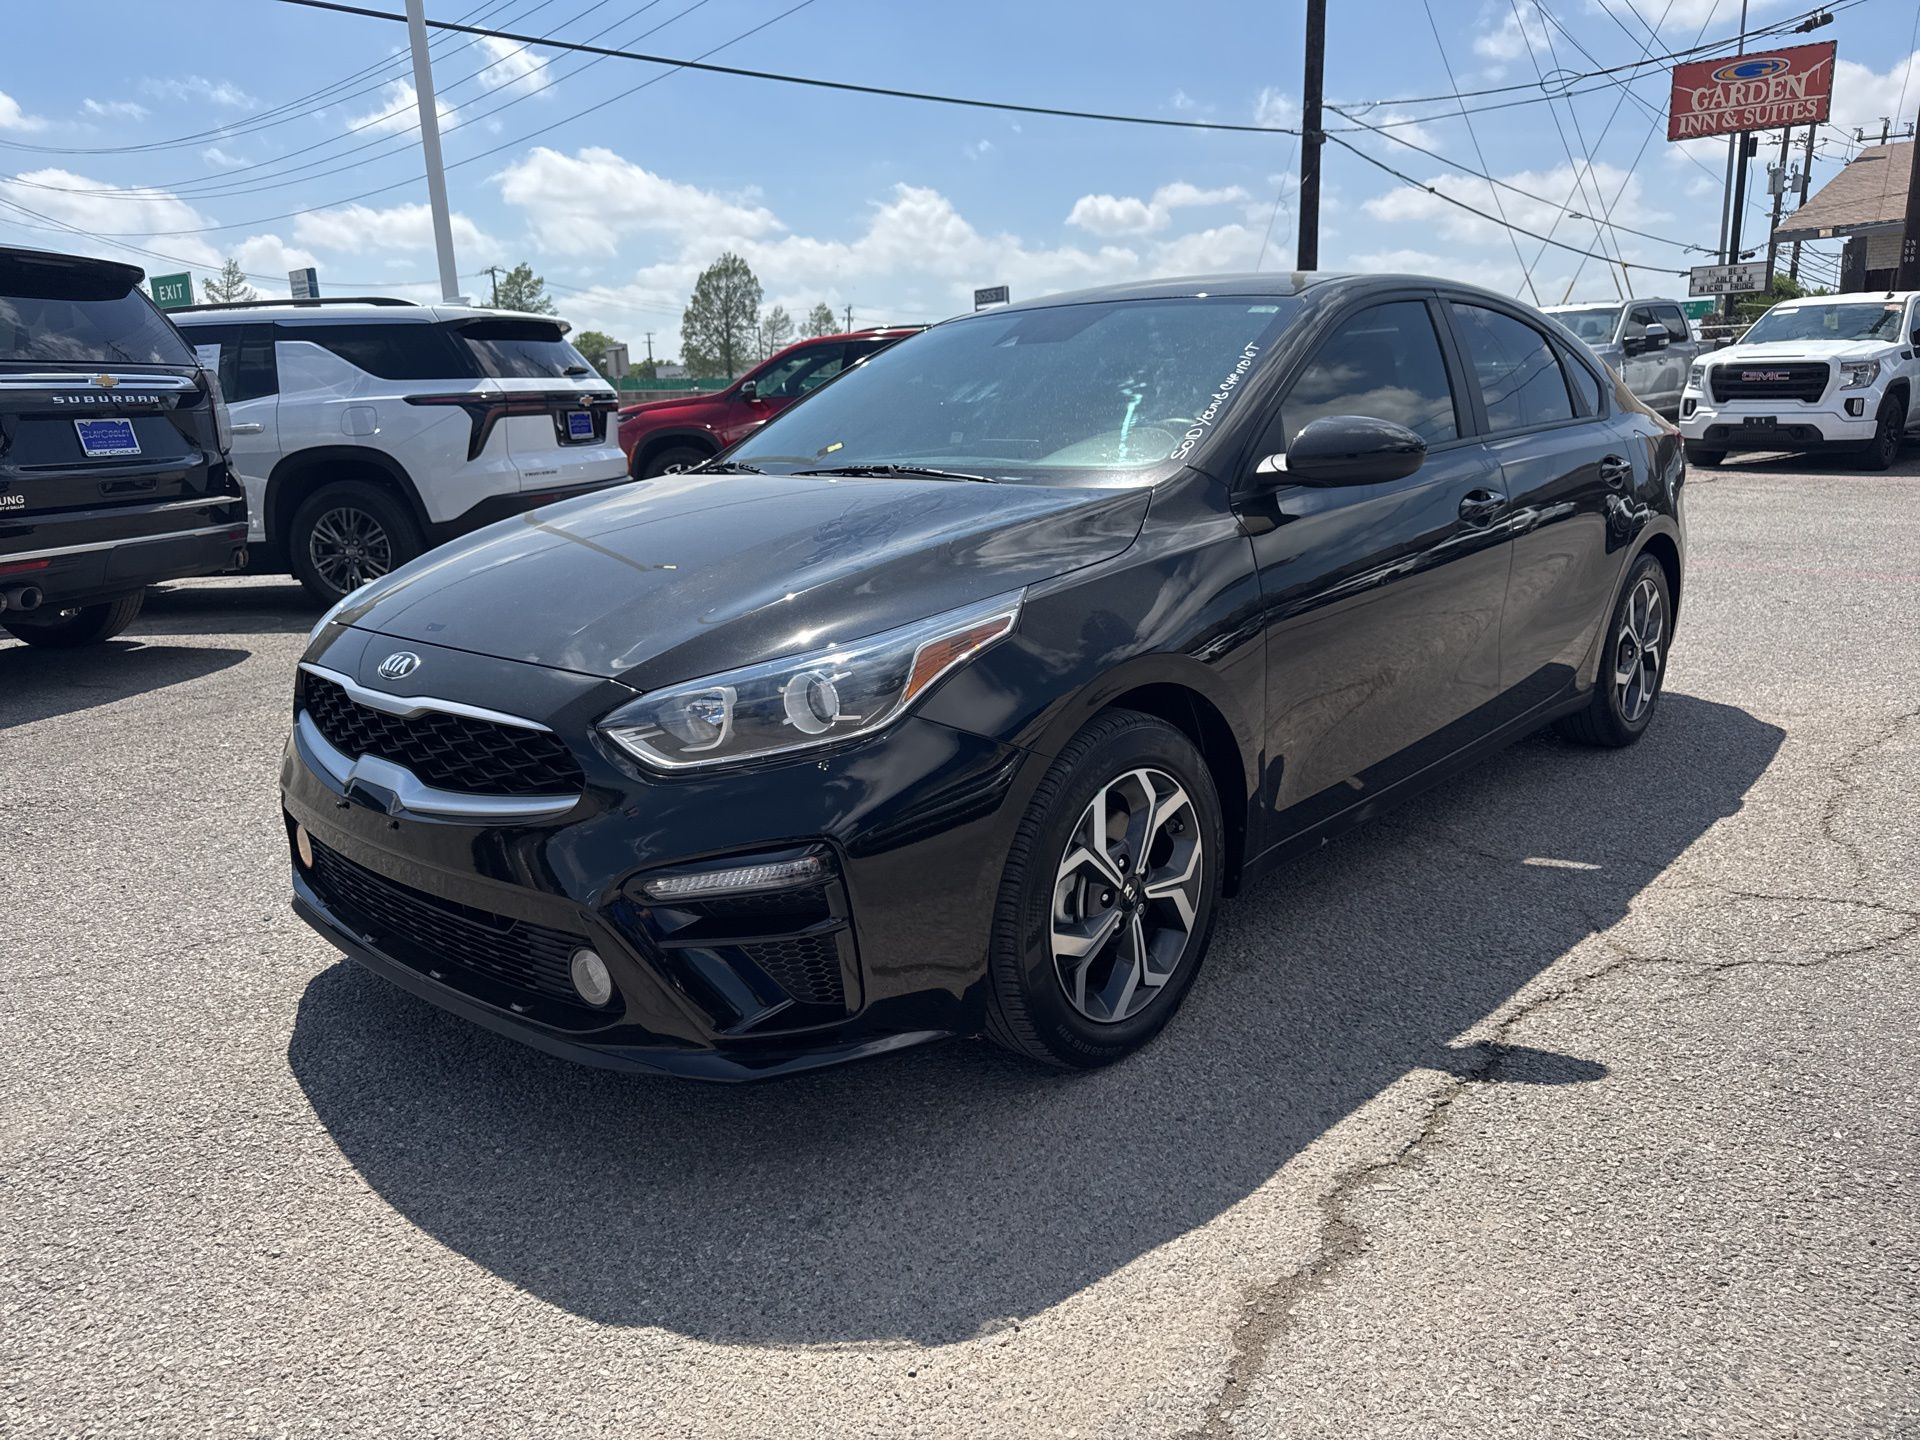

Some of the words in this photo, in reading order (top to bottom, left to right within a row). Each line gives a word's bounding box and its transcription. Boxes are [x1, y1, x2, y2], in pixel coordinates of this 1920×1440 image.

[1691, 73, 1808, 113] GARDEN
[1678, 113, 1718, 134] INN
[1722, 110, 1740, 127] &
[1744, 98, 1818, 125] SUITES
[158, 283, 183, 301] EXIT
[1741, 371, 1790, 381] GMC
[52, 395, 160, 404] SUBURBAN
[380, 653, 412, 675] KIA
